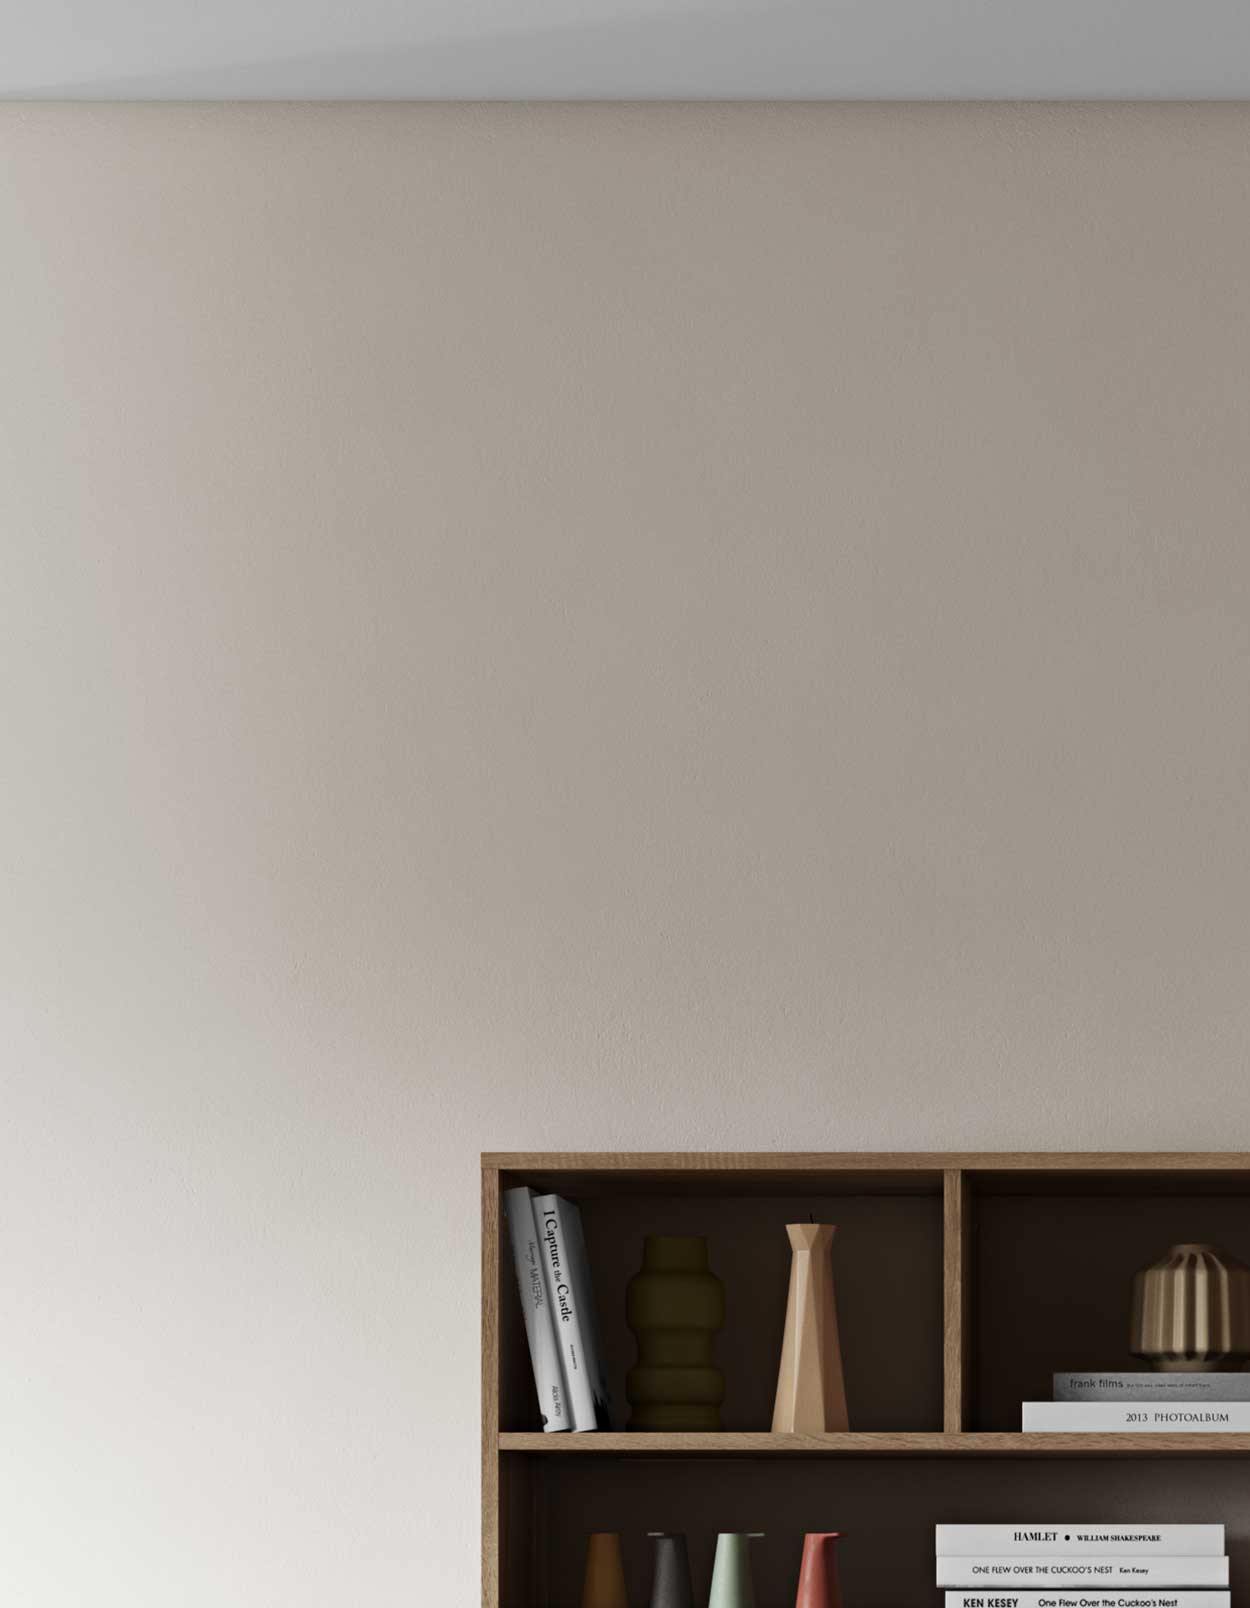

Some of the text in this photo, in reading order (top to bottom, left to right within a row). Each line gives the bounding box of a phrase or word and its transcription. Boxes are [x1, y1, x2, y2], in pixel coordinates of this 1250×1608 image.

[544, 1219, 560, 1268] Capture
[554, 1270, 562, 1282] the
[557, 1284, 572, 1322] Castle
[1070, 1378, 1096, 1389] frank
[1099, 1378, 1124, 1389] films
[1126, 1413, 1228, 1422] 2013 PHOTOALBUM
[1014, 1532, 1058, 1541] HAMLET
[972, 1566, 989, 1574] ONE
[992, 1566, 1011, 1574] FLEW
[1013, 1566, 1033, 1574] OVER
[1035, 1566, 1048, 1574] THE
[1051, 1566, 1092, 1574] CUCKOO'S
[1094, 1566, 1112, 1574] NEST
[1132, 1567, 1149, 1575] Kesey
[963, 1598, 984, 1608] KEN
[988, 1598, 1019, 1608] KESEY
[1038, 1599, 1056, 1607] One
[1059, 1599, 1078, 1607] Flew
[1079, 1599, 1100, 1607] Over
[1118, 1599, 1157, 1607] Cuckoo's
[1159, 1599, 1177, 1607] Nest
